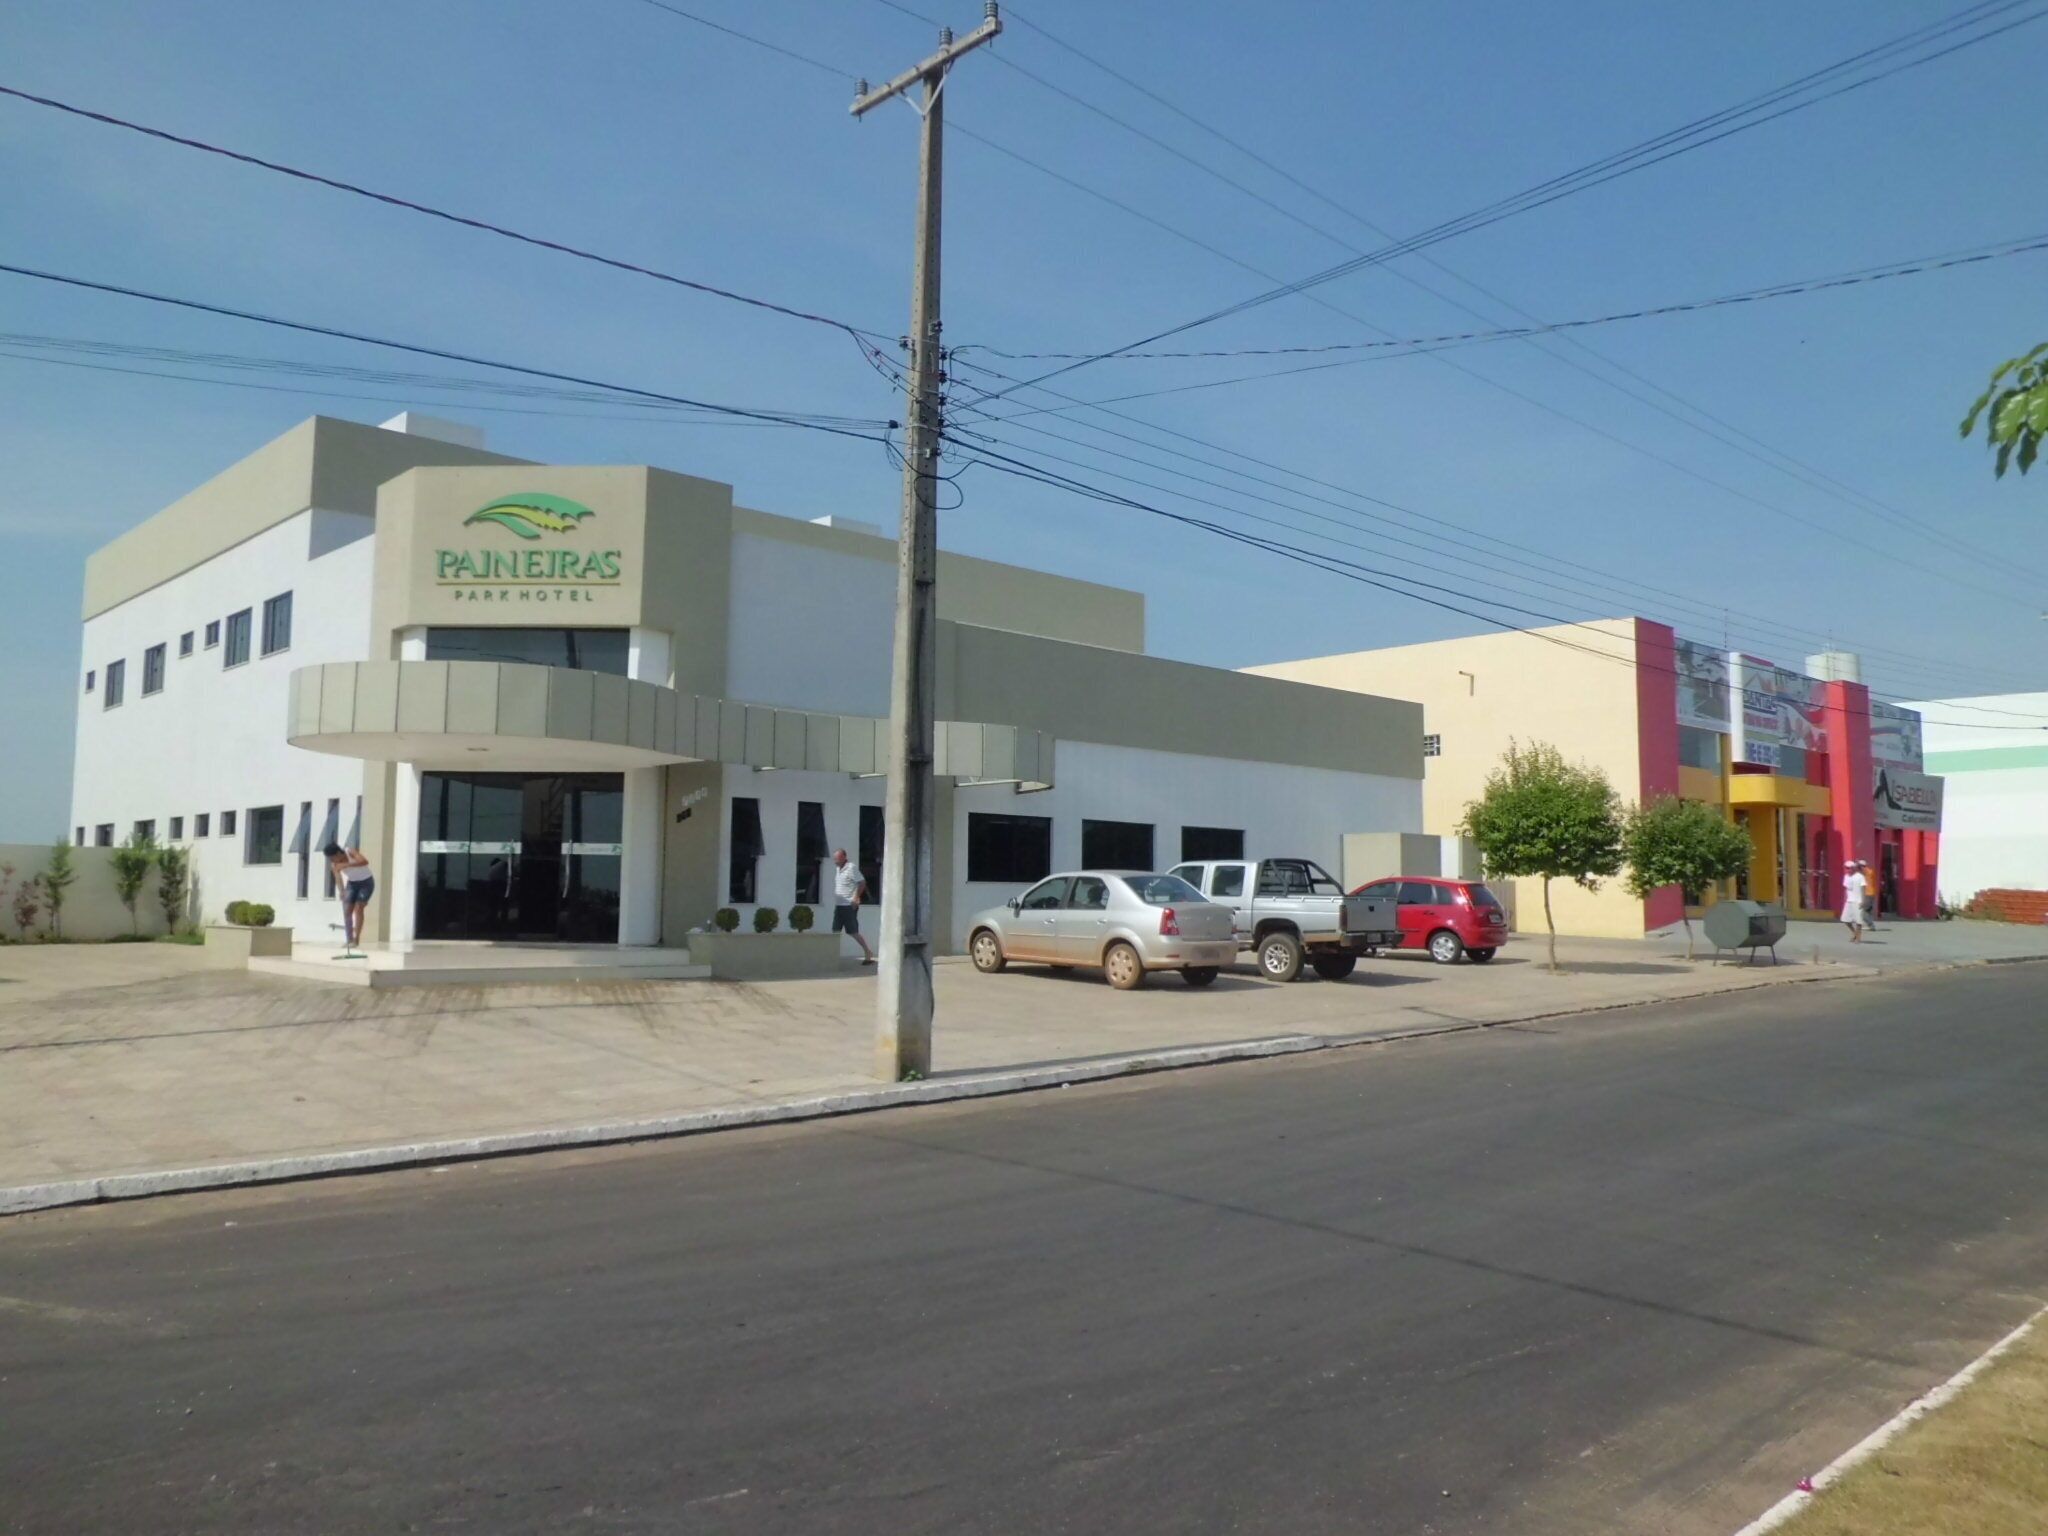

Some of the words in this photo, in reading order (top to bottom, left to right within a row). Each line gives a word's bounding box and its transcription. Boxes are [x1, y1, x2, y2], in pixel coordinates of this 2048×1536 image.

[436, 549, 622, 579] PAINEIRAS
[454, 590, 510, 601] PARK
[519, 590, 594, 602] HOTEL
